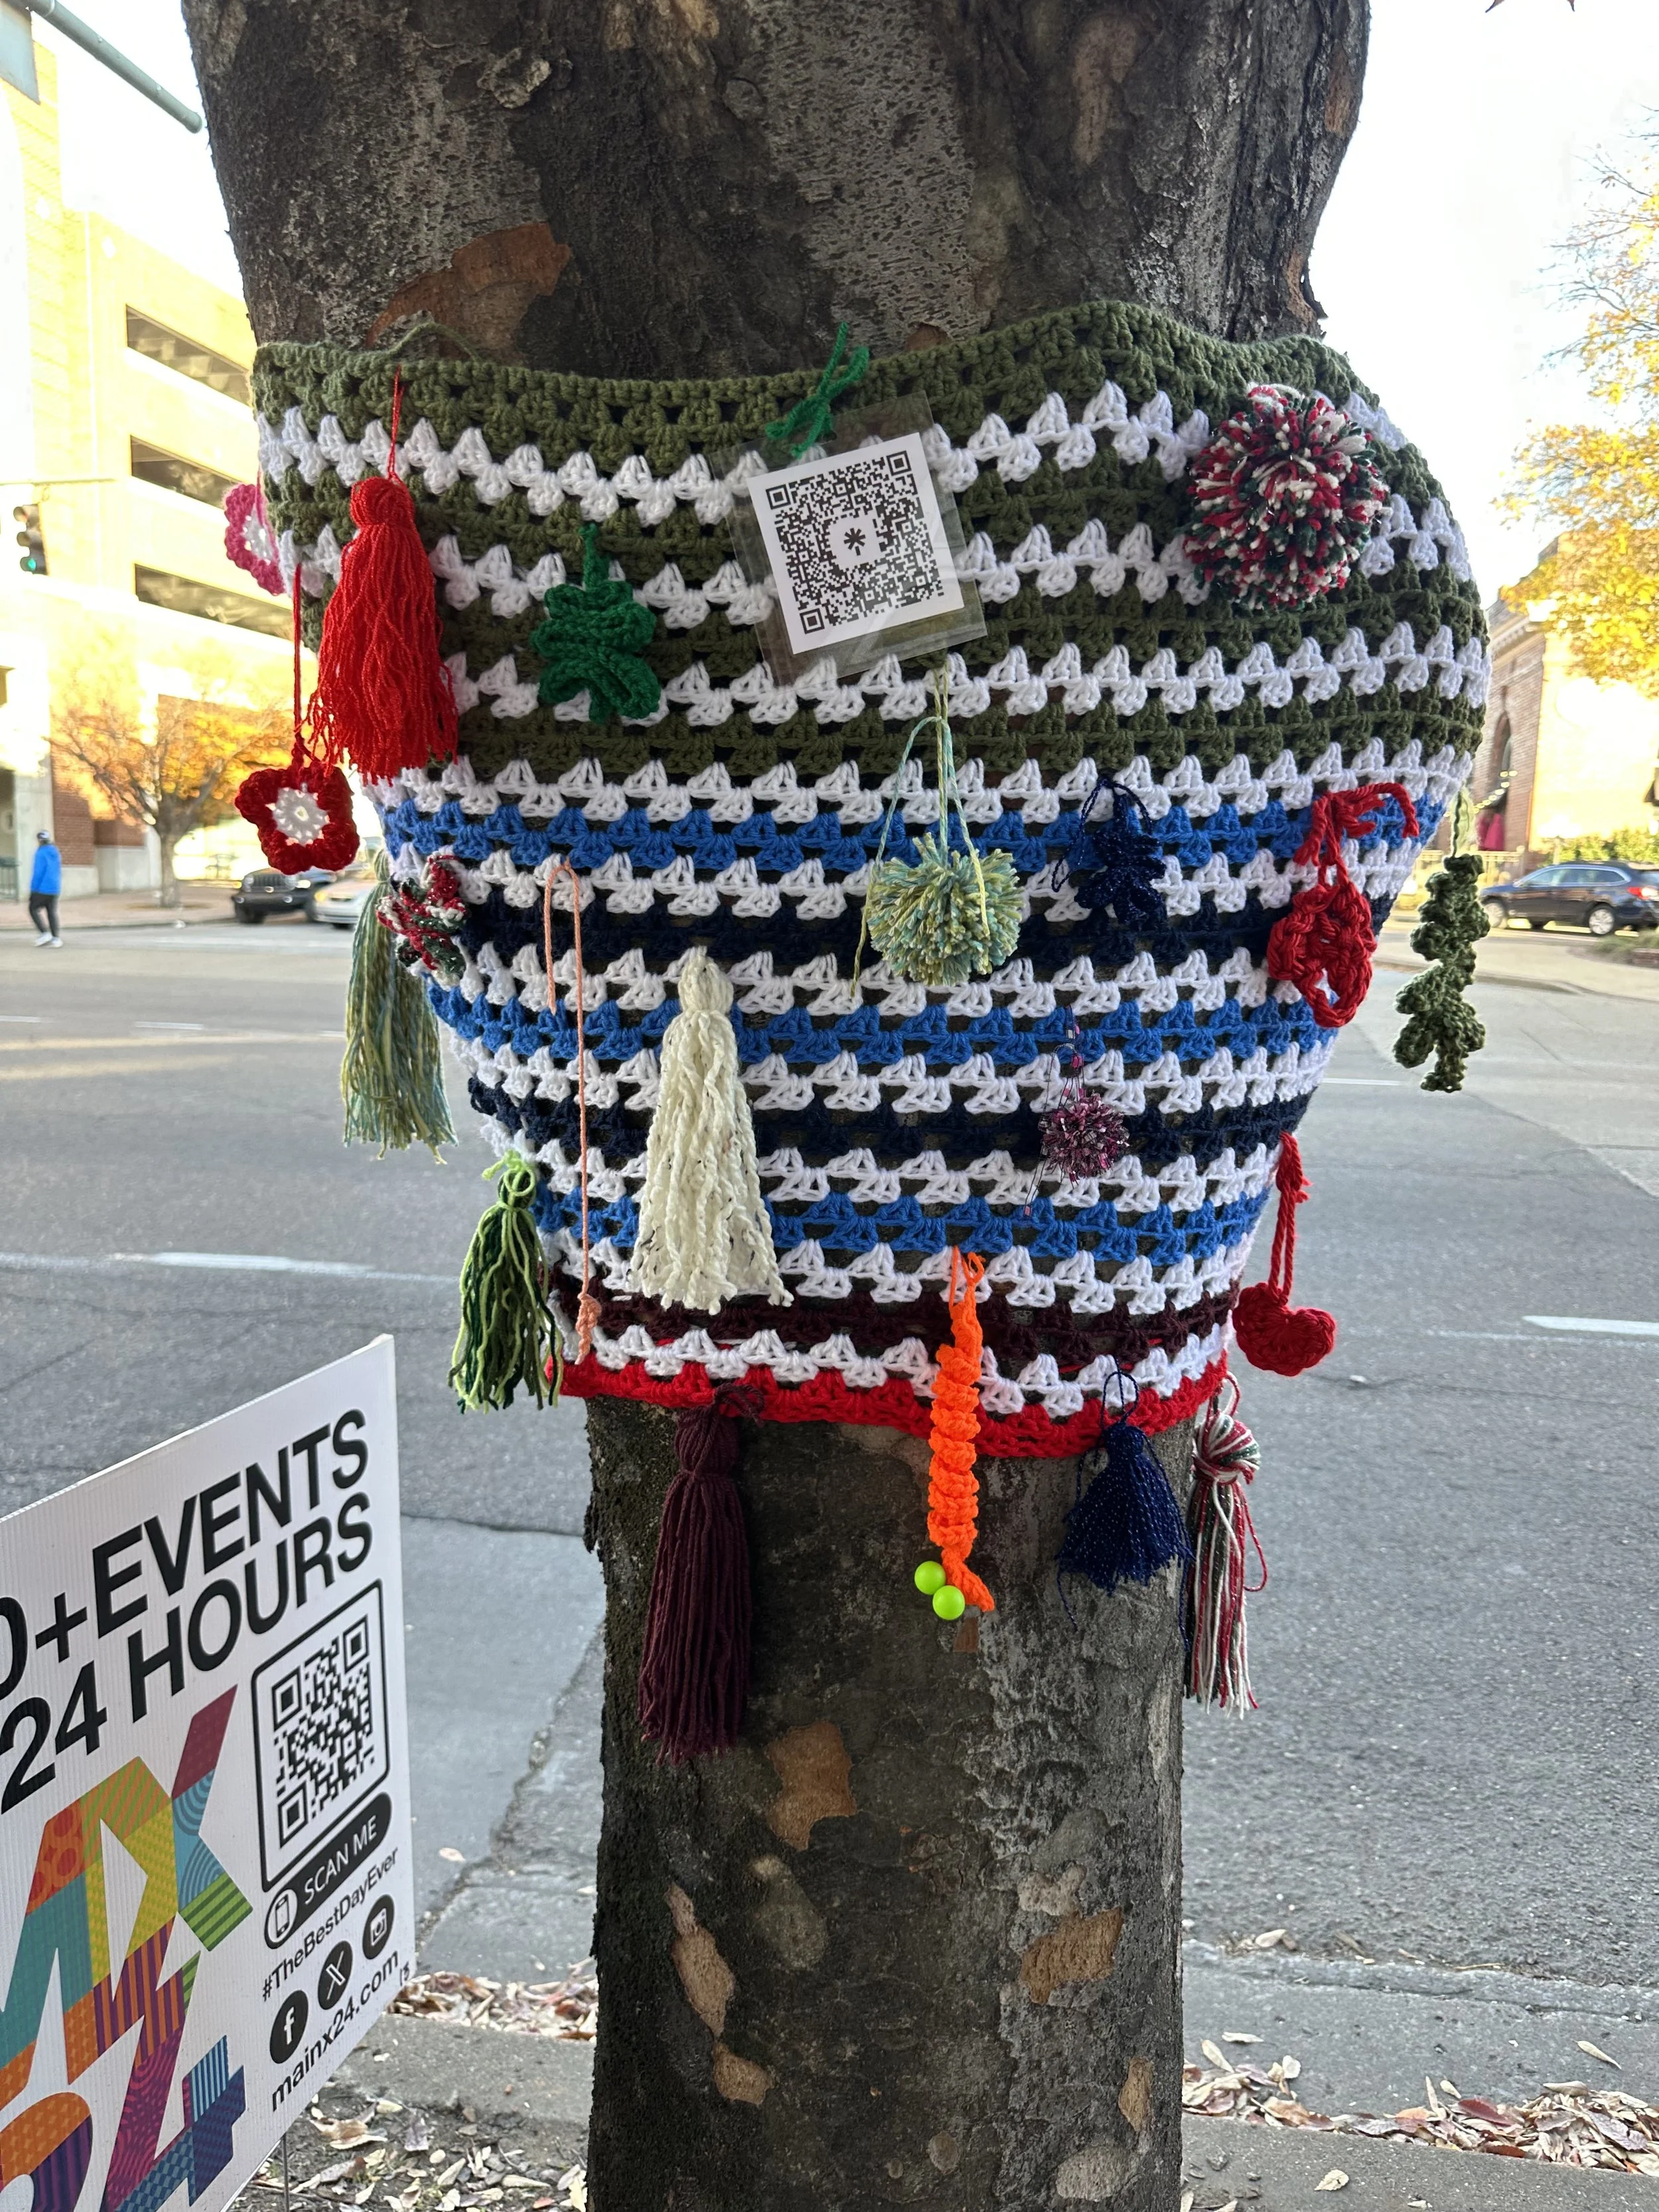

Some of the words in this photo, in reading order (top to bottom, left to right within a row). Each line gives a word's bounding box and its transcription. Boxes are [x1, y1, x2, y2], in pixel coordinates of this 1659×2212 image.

[0, 1660, 108, 1814] 24
[127, 1491, 373, 1724] HOURS
[263, 1847, 398, 2002] #TheBestDayEver
[305, 1842, 349, 1905] SCAN
[352, 1814, 378, 1856] ME
[272, 1950, 398, 2112] mainx24.com
